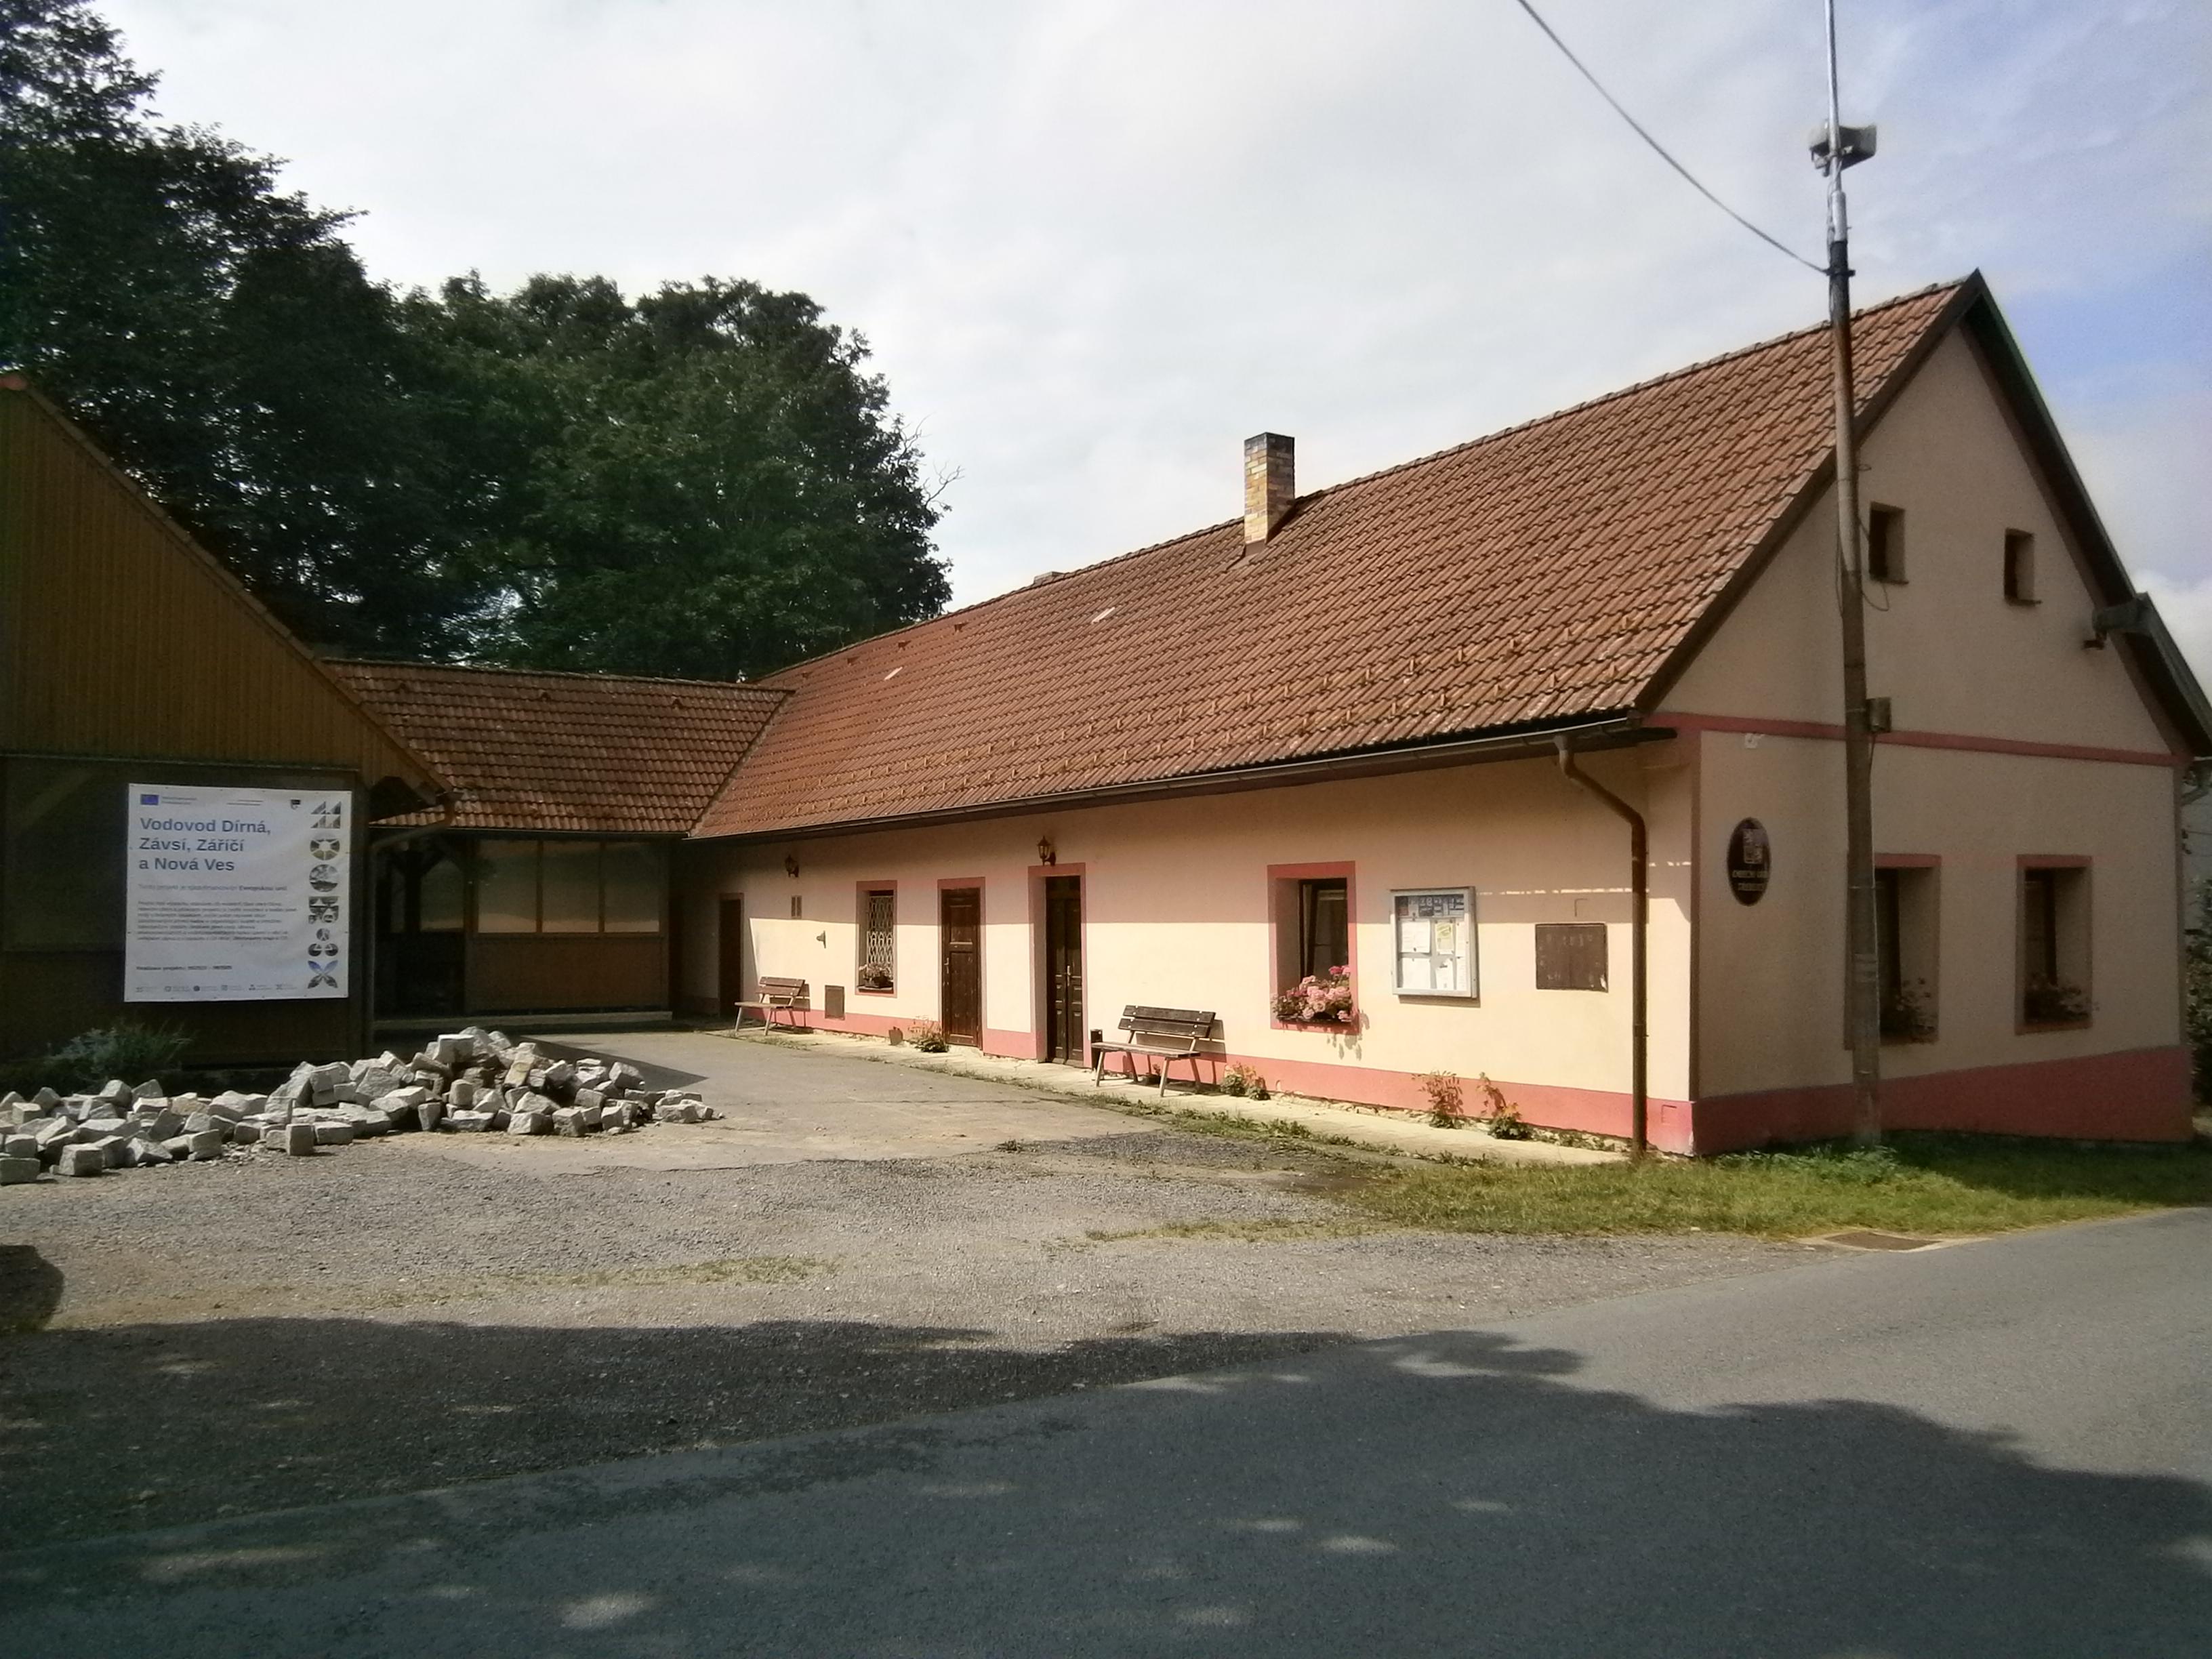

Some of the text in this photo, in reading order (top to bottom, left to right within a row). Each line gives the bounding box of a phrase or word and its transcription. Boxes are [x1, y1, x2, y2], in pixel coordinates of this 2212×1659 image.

[140, 817, 271, 835] Vodovod Dírná,
[139, 837, 245, 853] Závsí, Záříčí
[139, 857, 235, 872] a Nová Ves
